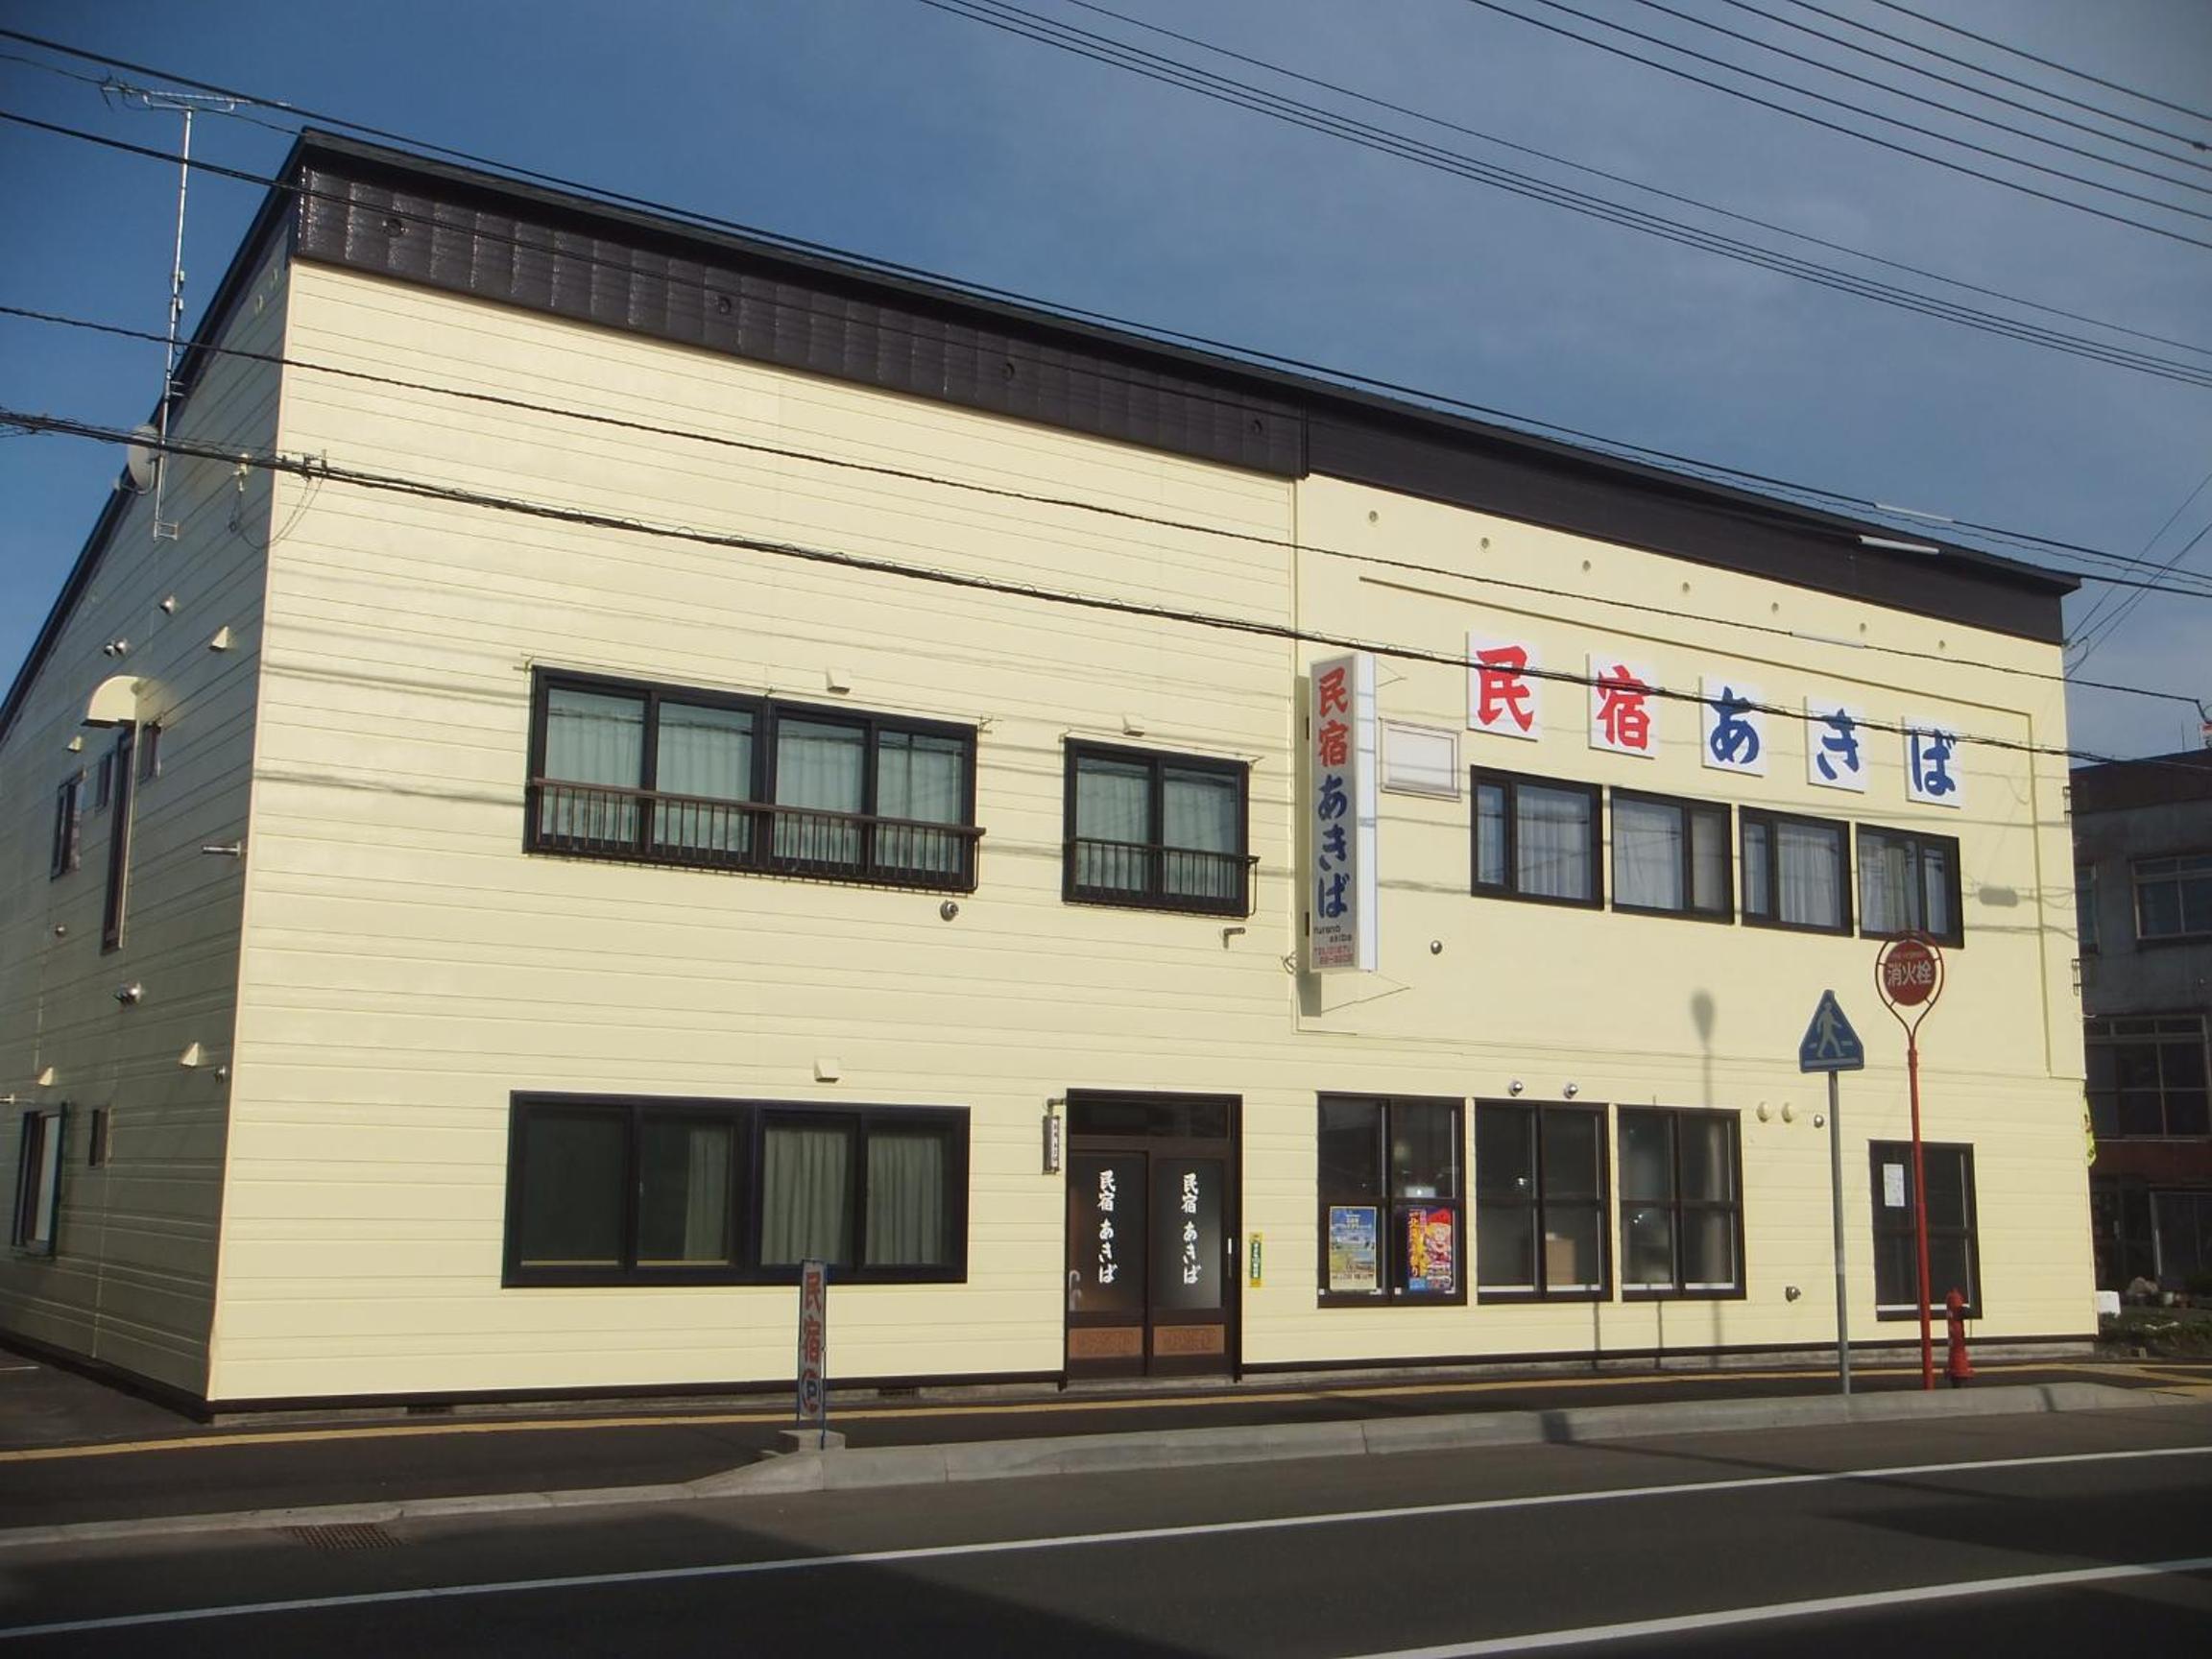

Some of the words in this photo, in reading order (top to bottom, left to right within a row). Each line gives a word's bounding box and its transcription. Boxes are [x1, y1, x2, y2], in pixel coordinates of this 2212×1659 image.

[1475, 644, 1957, 797] 民宿あきば
[1318, 666, 1350, 919] 民宿あきば
[1887, 960, 1932, 986] 消火栓
[1096, 1169, 1118, 1284] 民宿あきば
[1180, 1173, 1201, 1285] 民宿あきば
